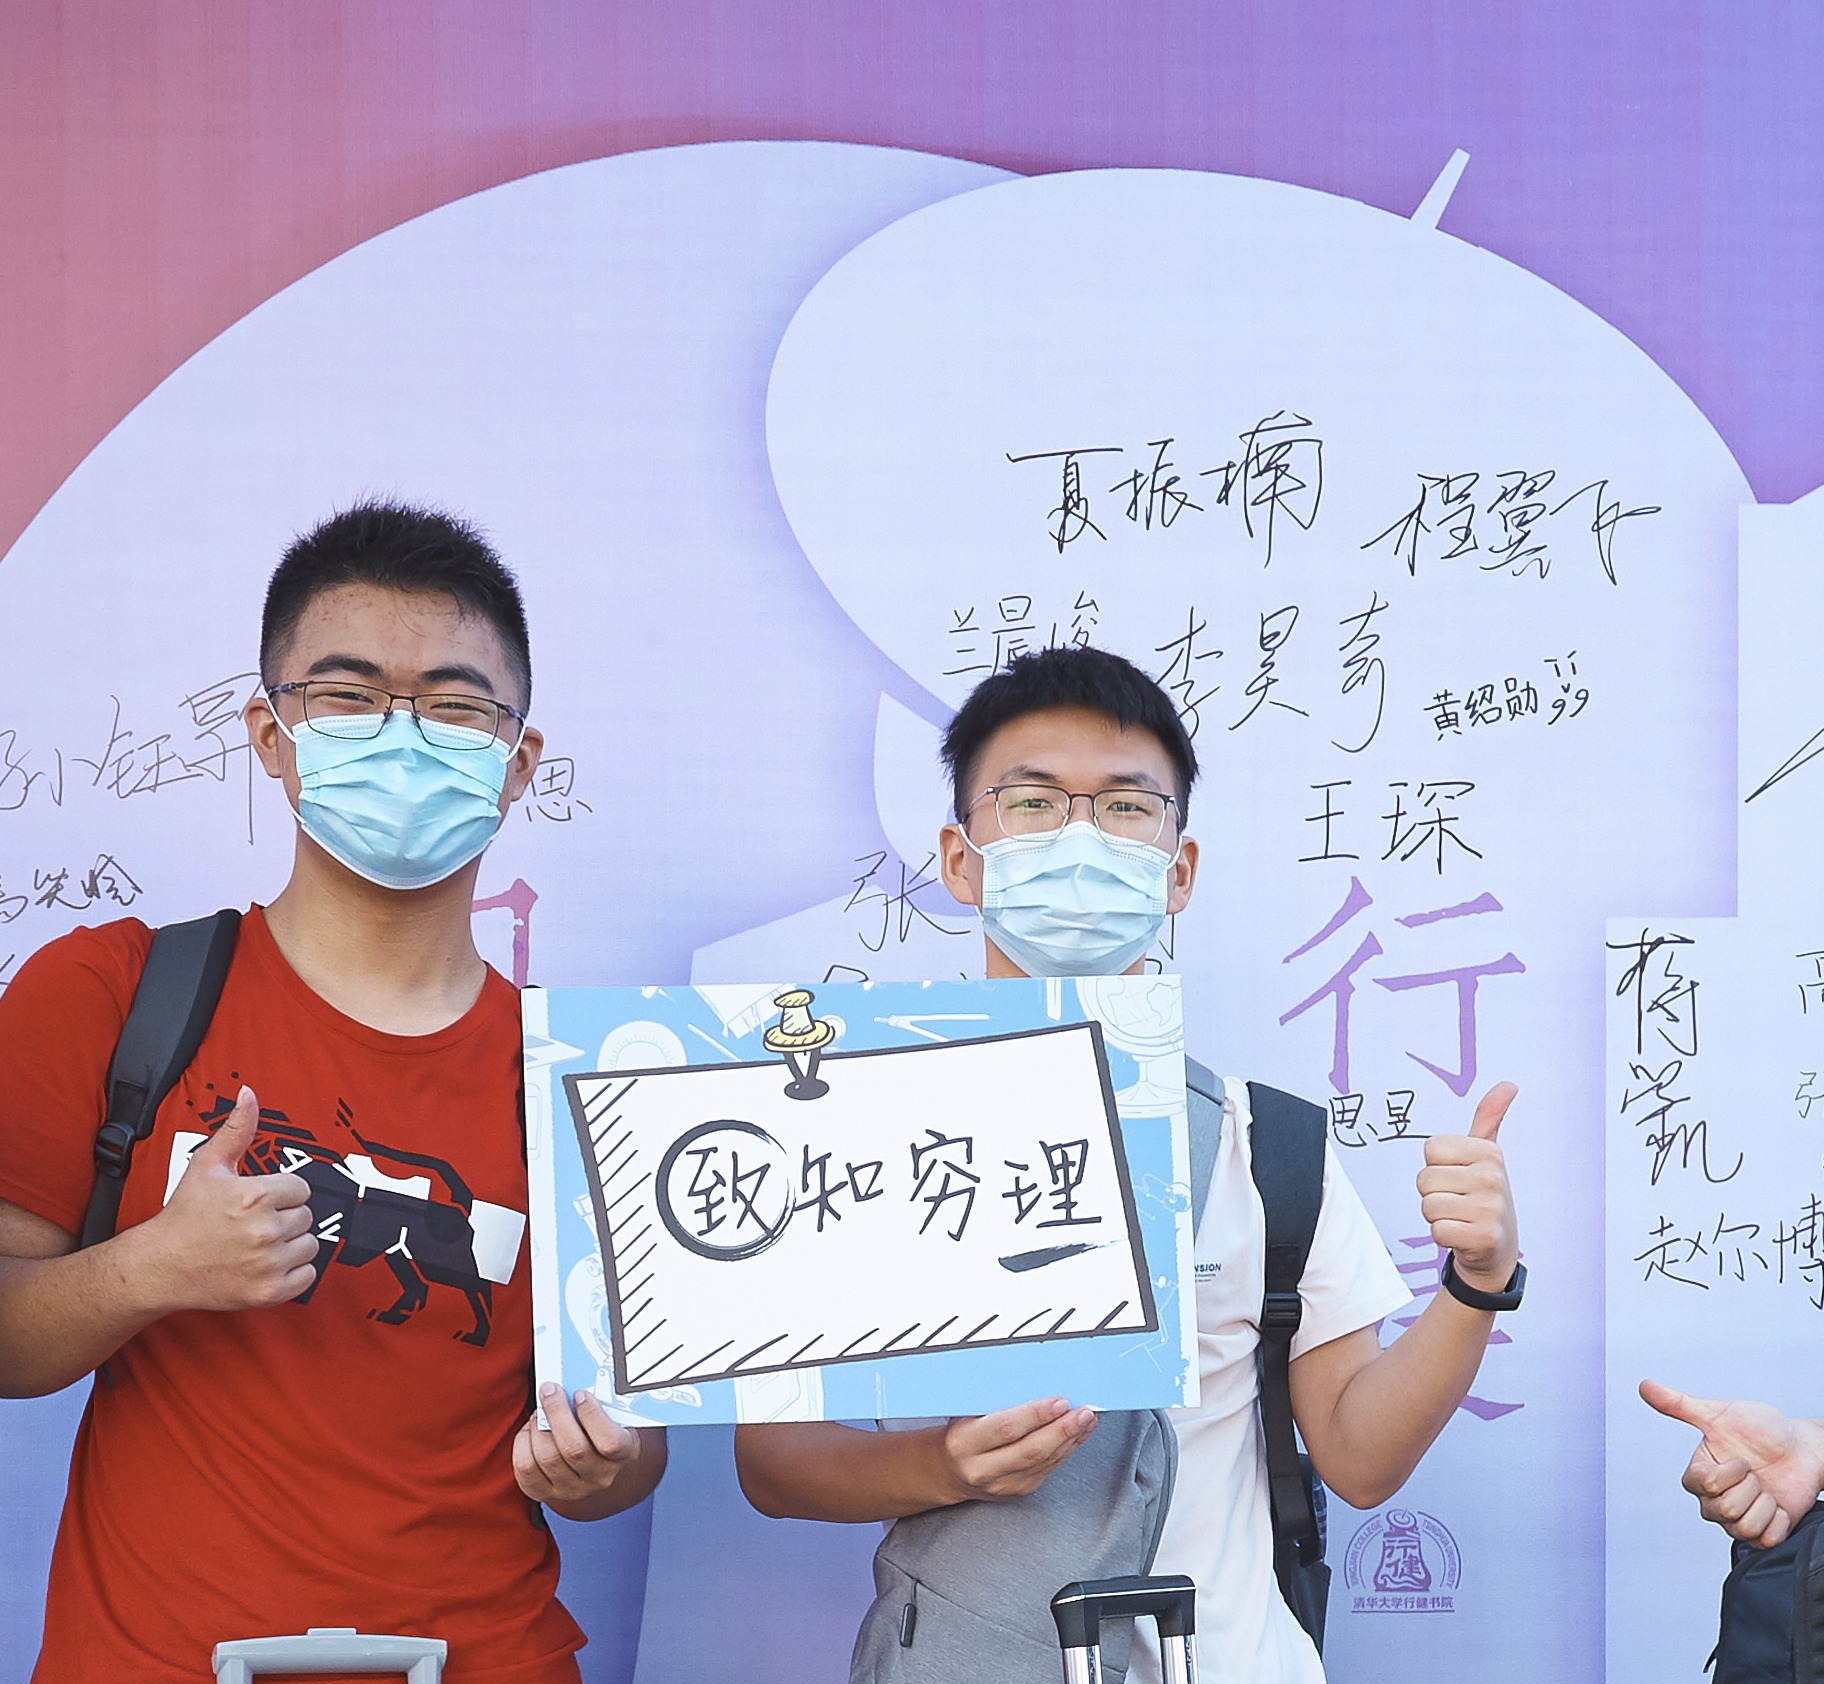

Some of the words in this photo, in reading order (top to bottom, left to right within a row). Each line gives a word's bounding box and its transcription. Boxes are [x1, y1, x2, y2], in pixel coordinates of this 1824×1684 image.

[1007, 410, 1323, 568] 夏振楠
[1423, 675, 1539, 741] 黄绍勋
[1299, 780, 1482, 875] 王琛
[686, 1127, 1102, 1241] 致知穷理
